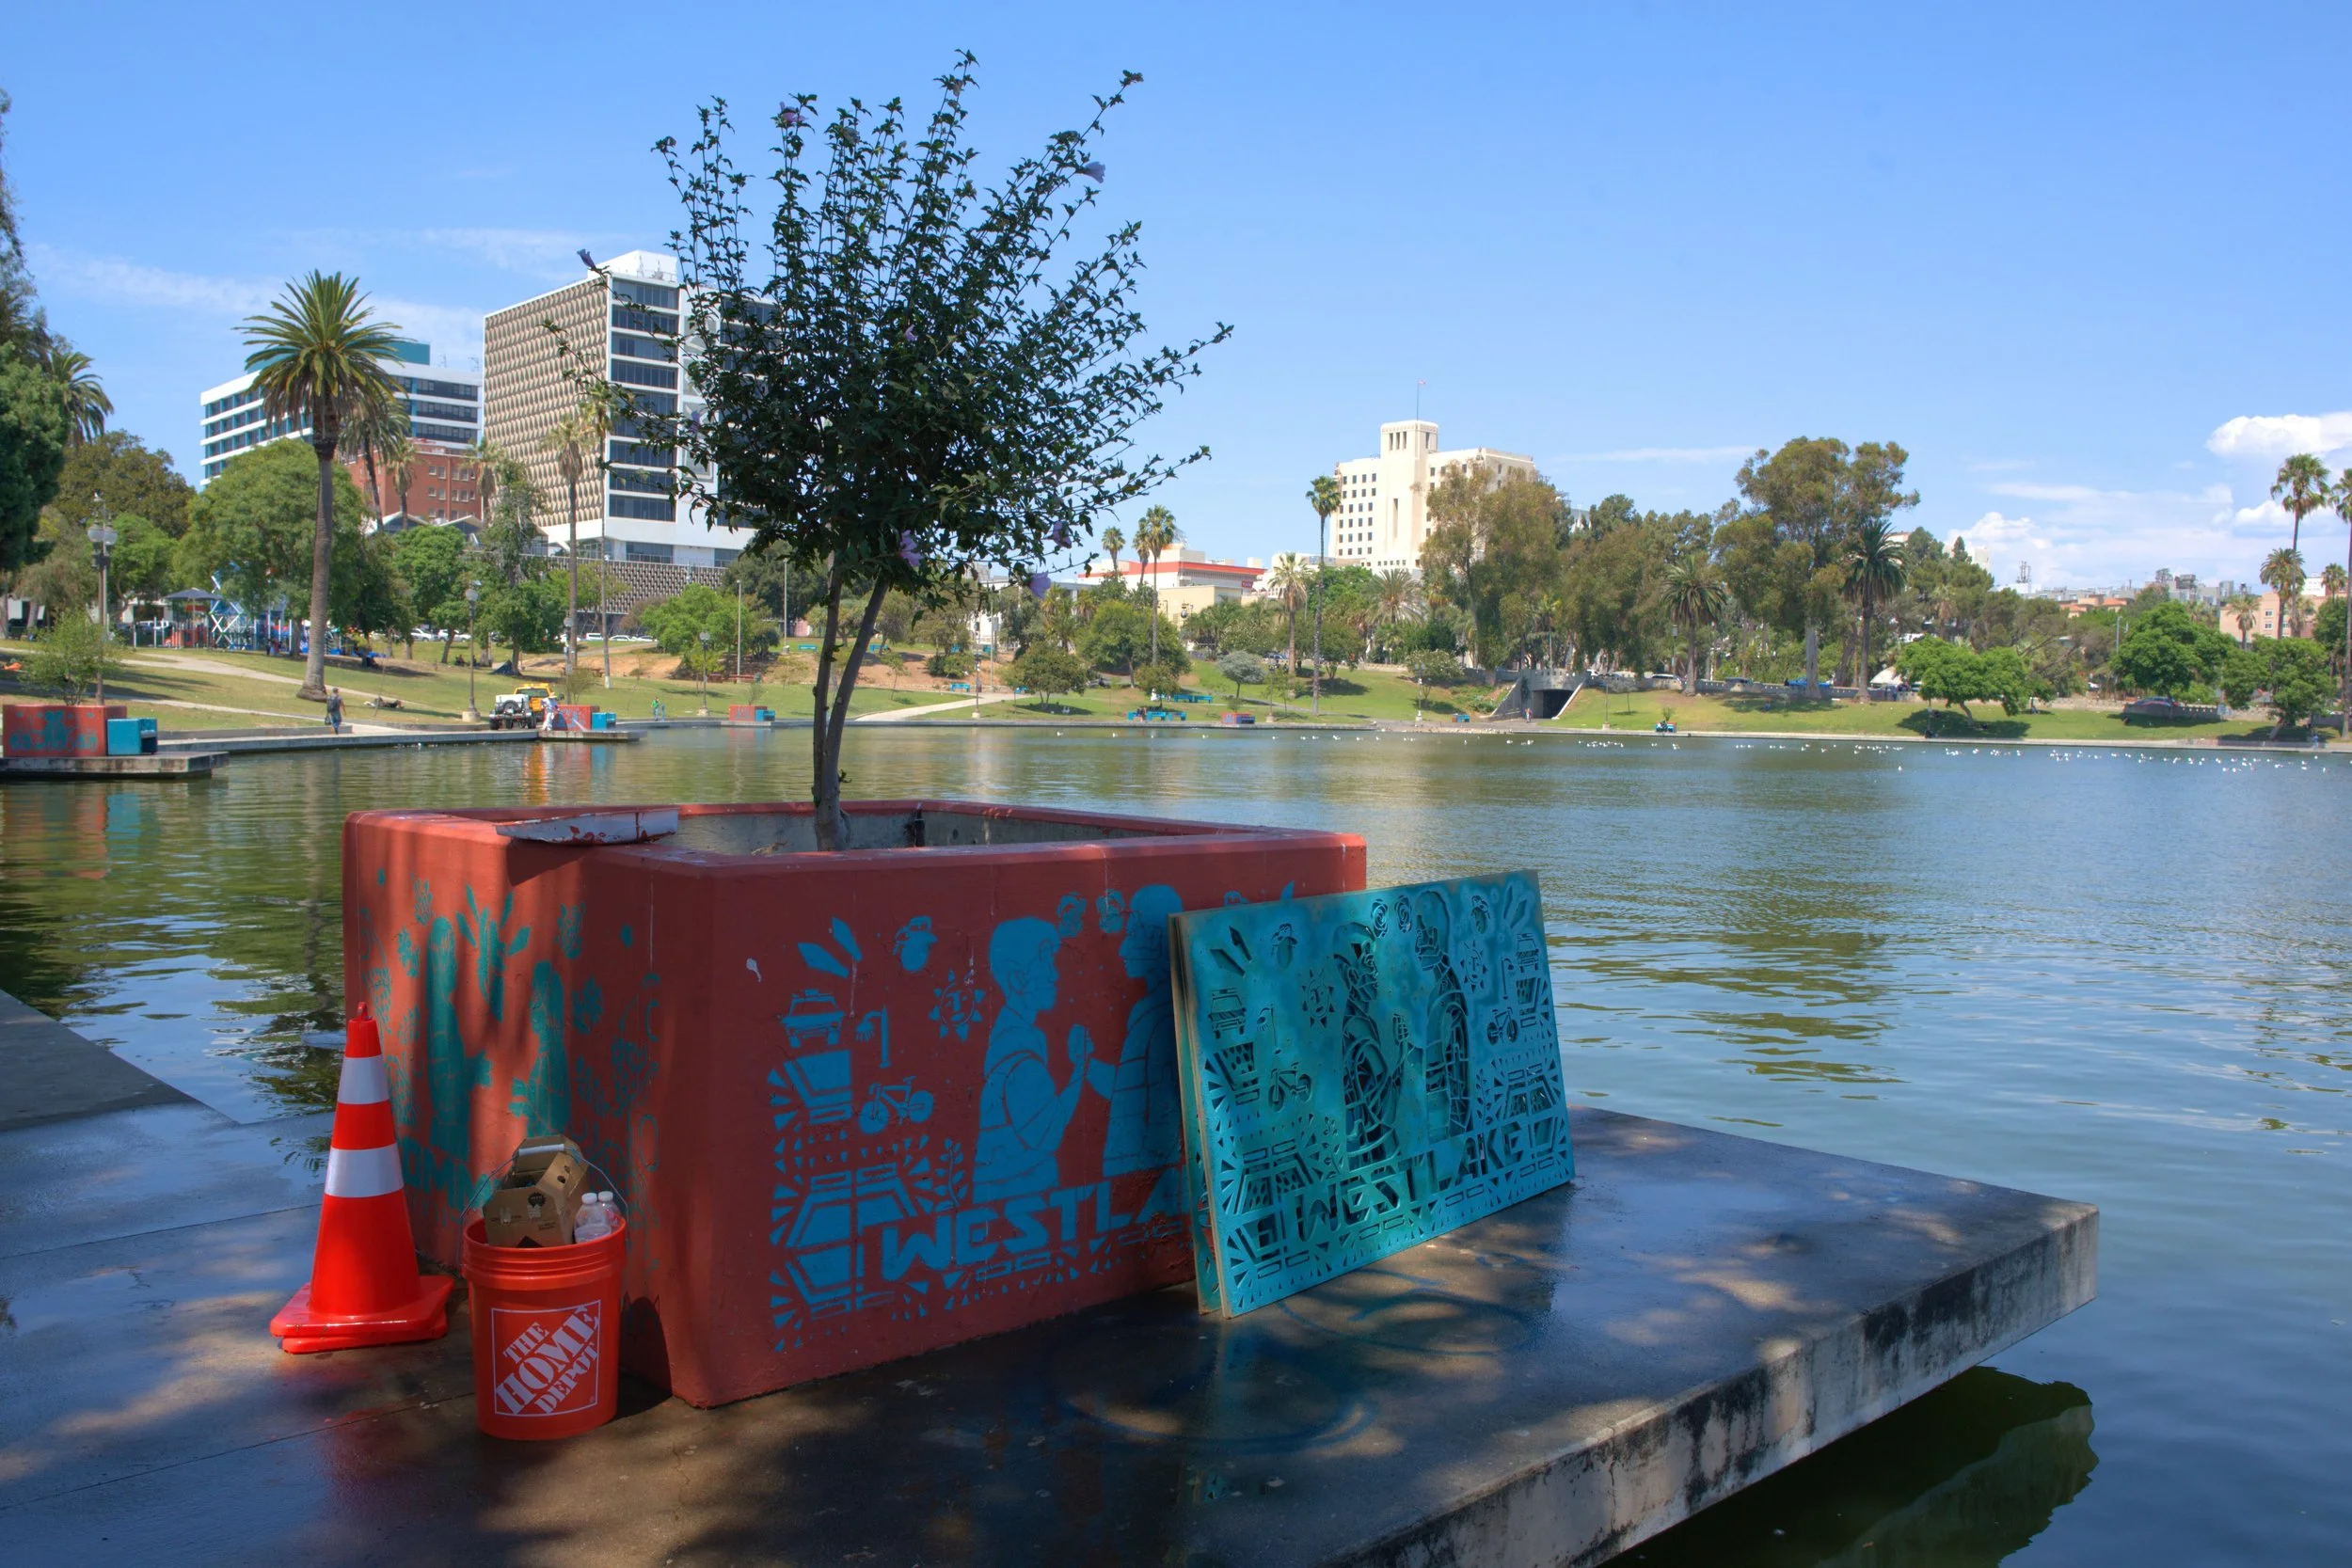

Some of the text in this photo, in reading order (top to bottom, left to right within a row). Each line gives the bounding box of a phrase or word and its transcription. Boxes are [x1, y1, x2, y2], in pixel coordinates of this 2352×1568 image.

[881, 1165, 1191, 1281] WESTLA
[1294, 1120, 1525, 1243] WESTLAKE
[496, 1306, 599, 1415] HOME
[502, 1322, 550, 1364] THE
[534, 1341, 598, 1415] DEPOT
